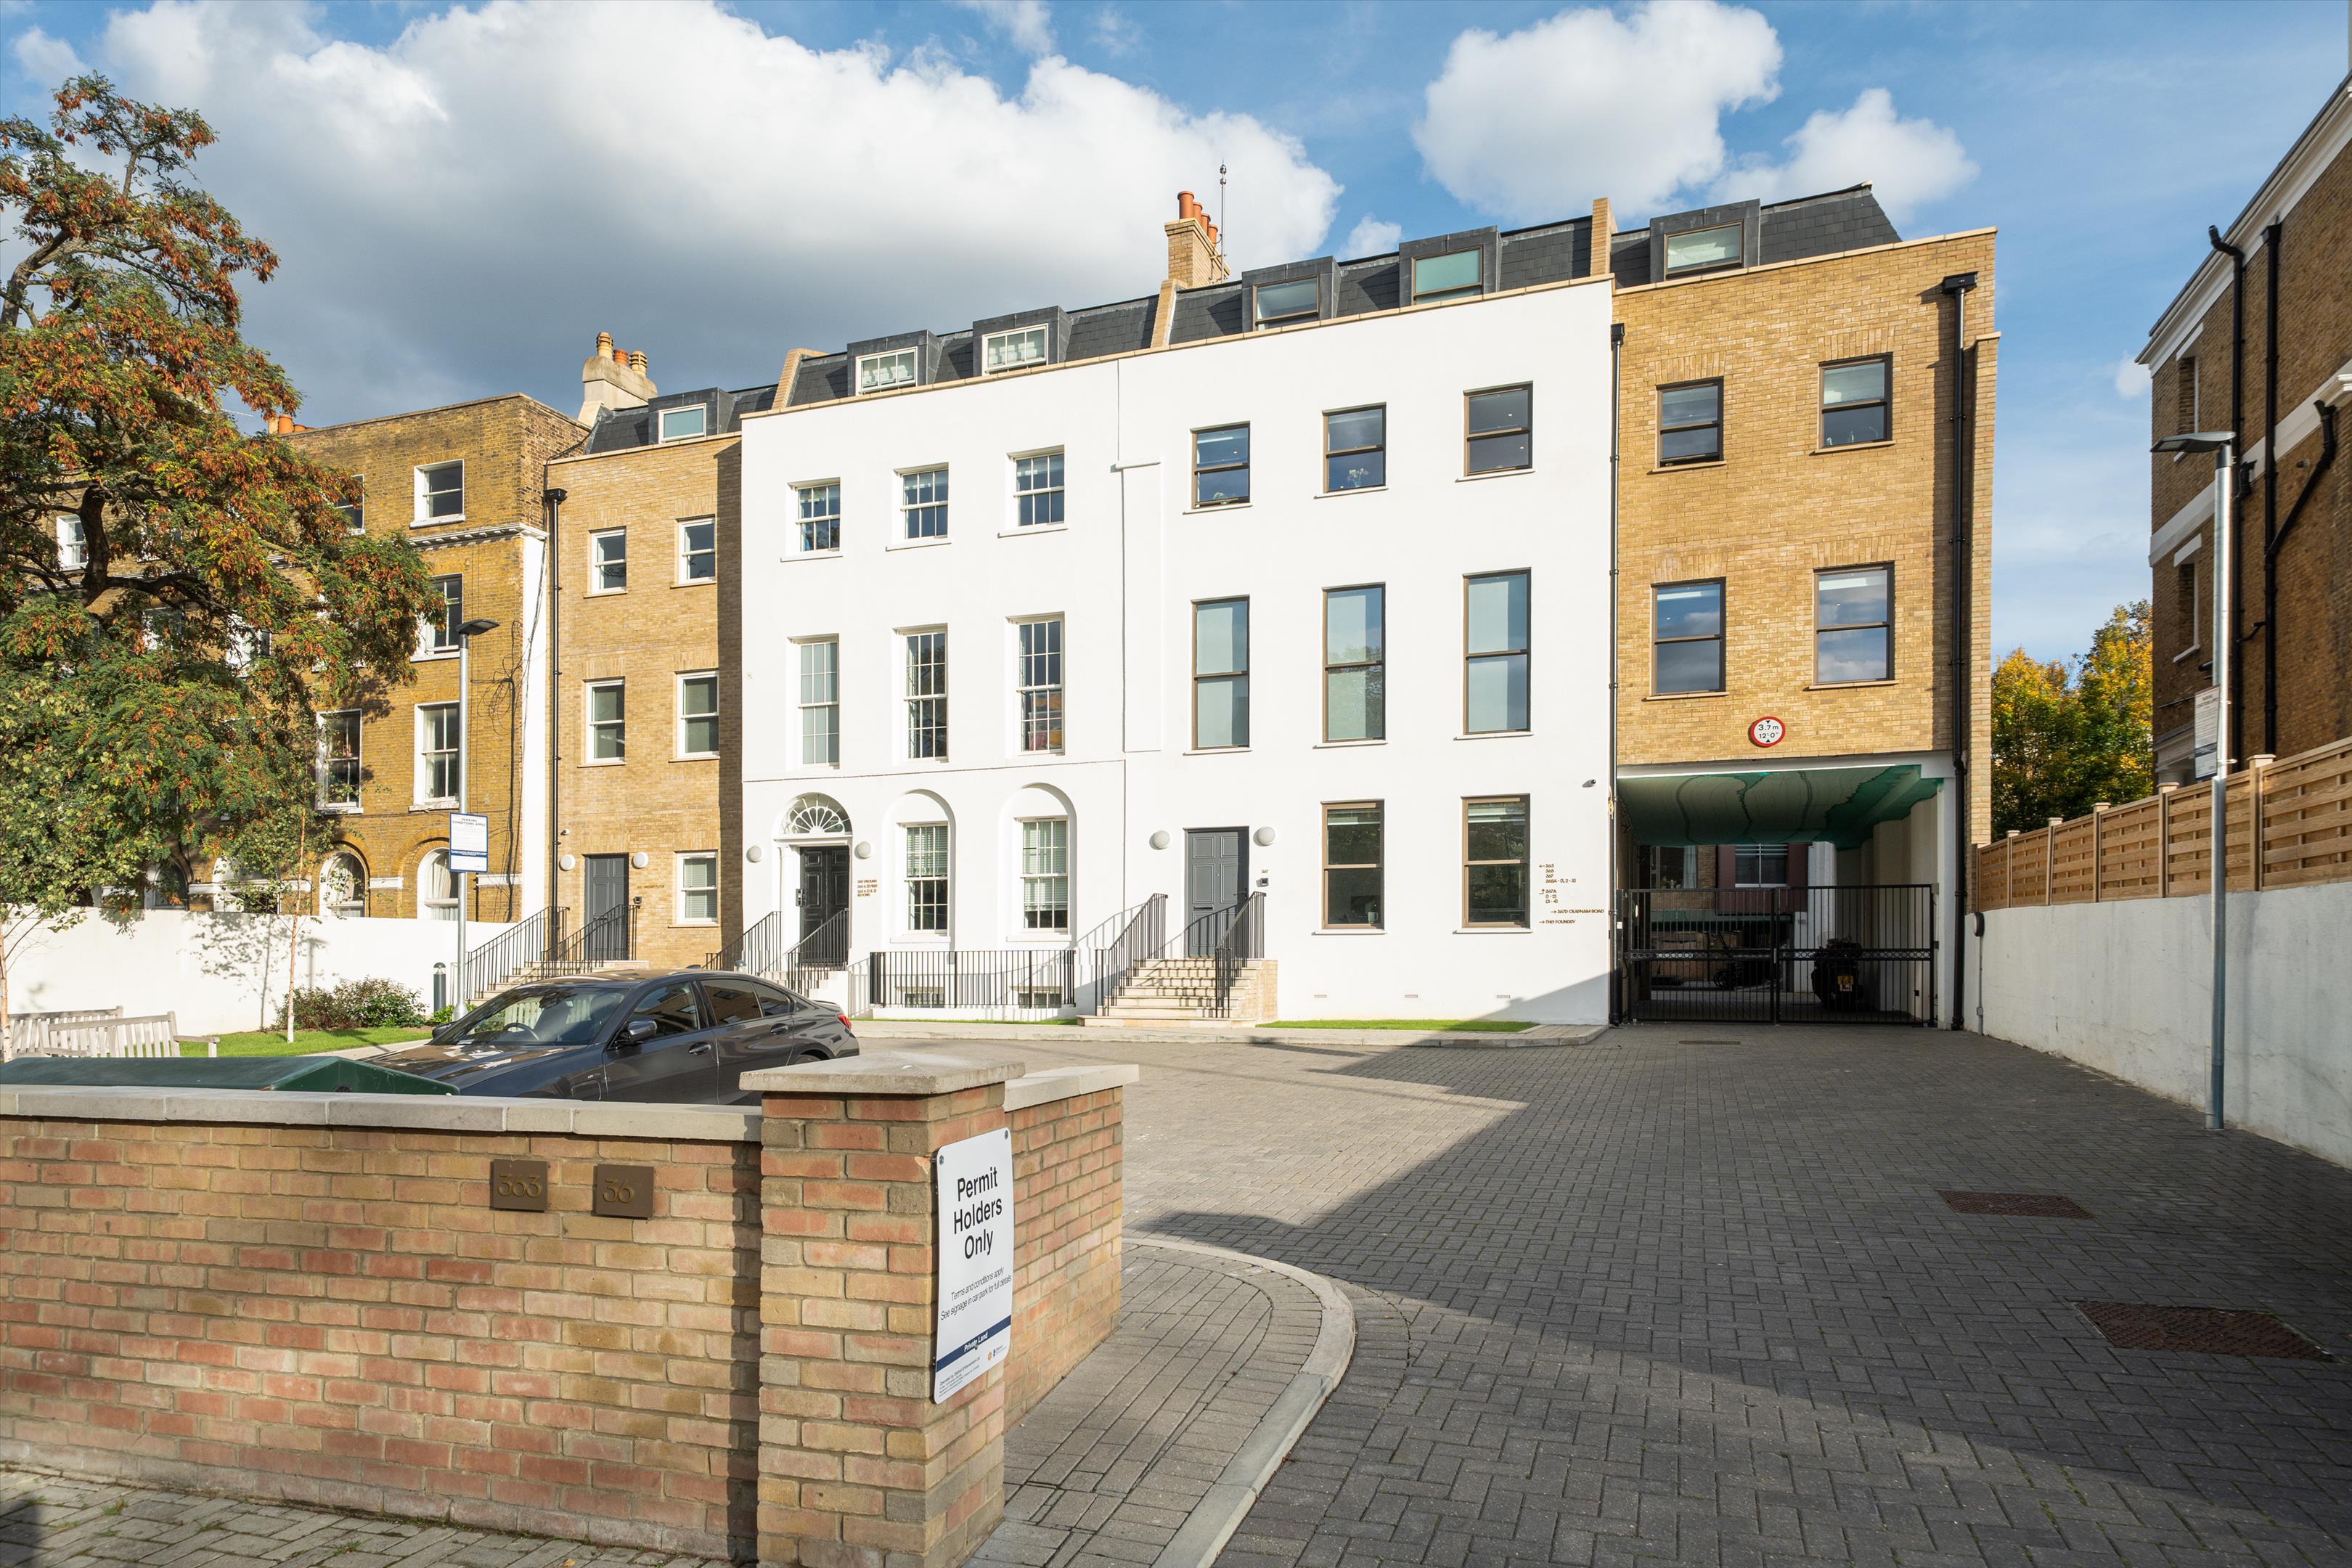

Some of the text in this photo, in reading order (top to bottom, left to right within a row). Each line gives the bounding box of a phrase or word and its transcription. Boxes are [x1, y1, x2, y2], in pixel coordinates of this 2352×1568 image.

[497, 1172, 542, 1198] 363
[957, 1167, 998, 1202] Permit
[954, 1199, 1003, 1235] Holders
[964, 1229, 994, 1259] Only
[941, 1310, 950, 1320] See
[950, 1300, 967, 1316] signage
[968, 1296, 973, 1305] in
[979, 1287, 989, 1301] park
[1000, 1274, 1012, 1287] details
[951, 1288, 965, 1301] Terms
[973, 1273, 994, 1289] conditions
[993, 1266, 1005, 1278] apply
[978, 1331, 989, 1344] Land
